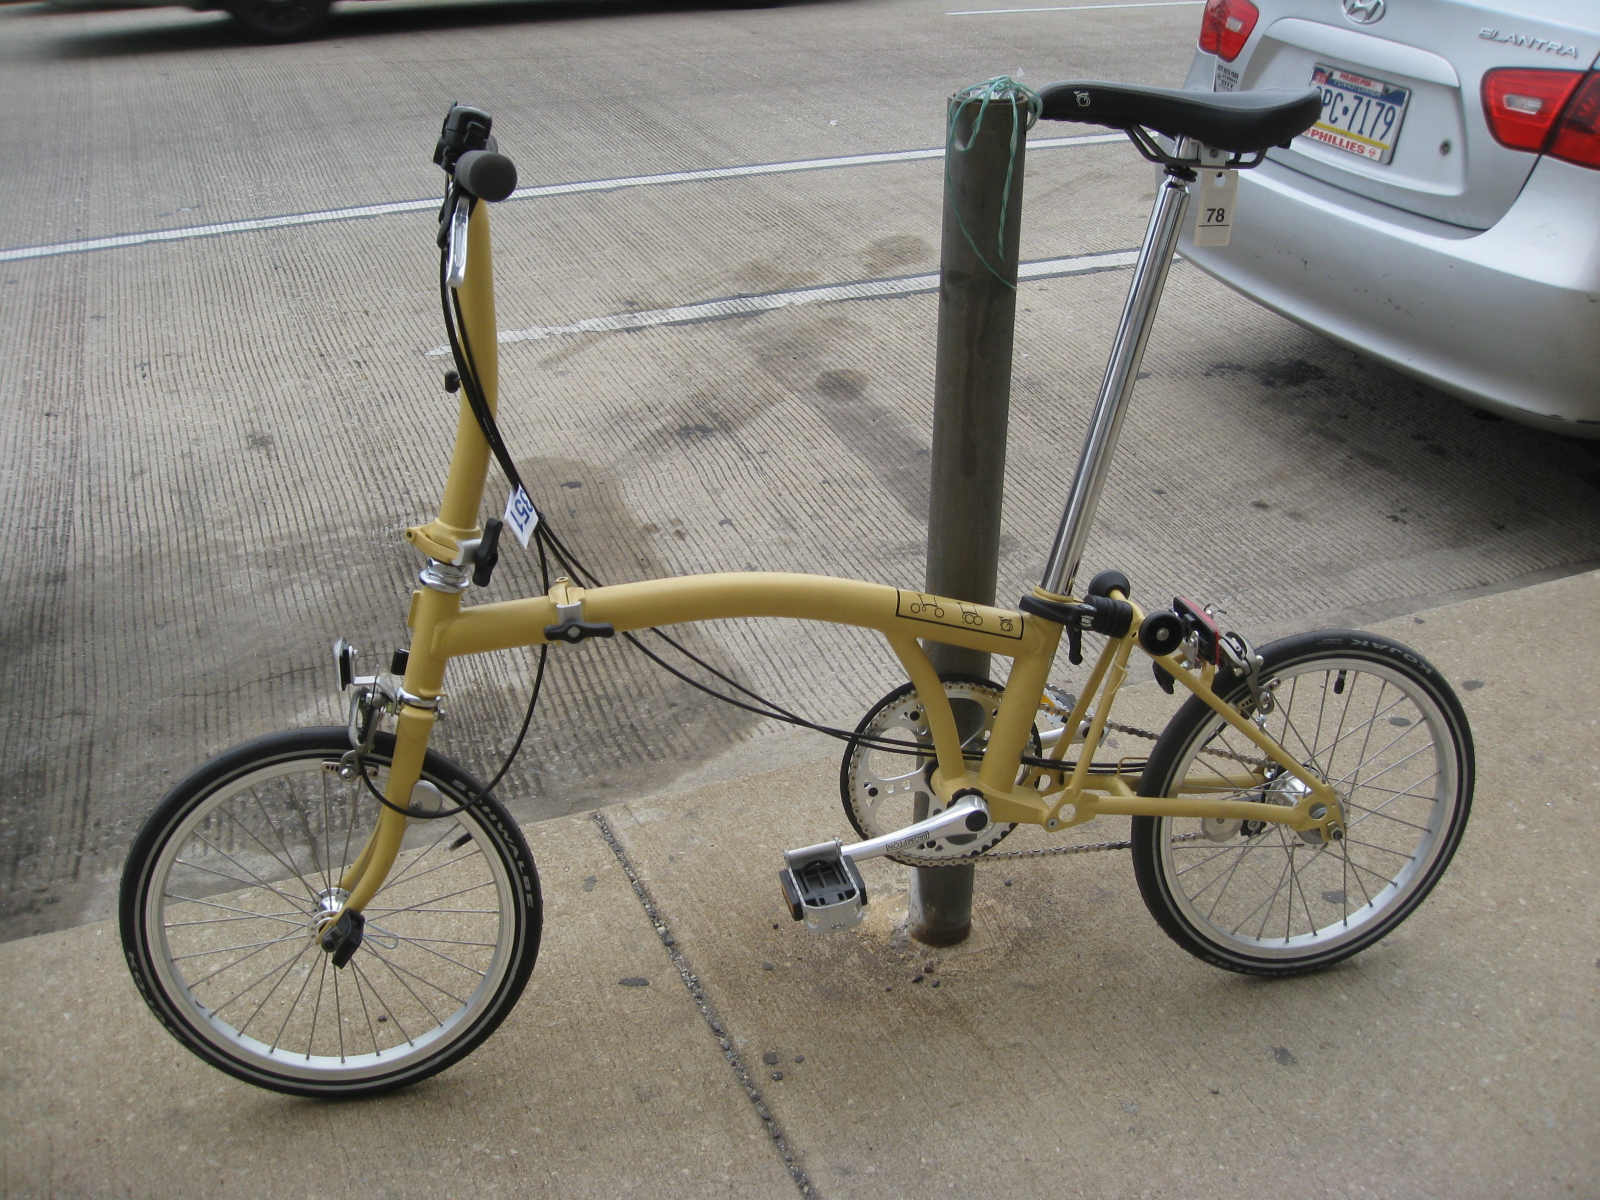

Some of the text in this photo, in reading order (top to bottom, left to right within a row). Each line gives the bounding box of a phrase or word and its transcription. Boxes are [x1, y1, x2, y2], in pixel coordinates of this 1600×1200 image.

[1479, 27, 1578, 59] ELANTRA
[1310, 128, 1367, 155] PHILLIES
[1206, 207, 1226, 223] 78
[1350, 638, 1432, 675] KOJAK
[451, 778, 535, 909] SCHWALBE
[886, 832, 930, 852] BROMPTON
